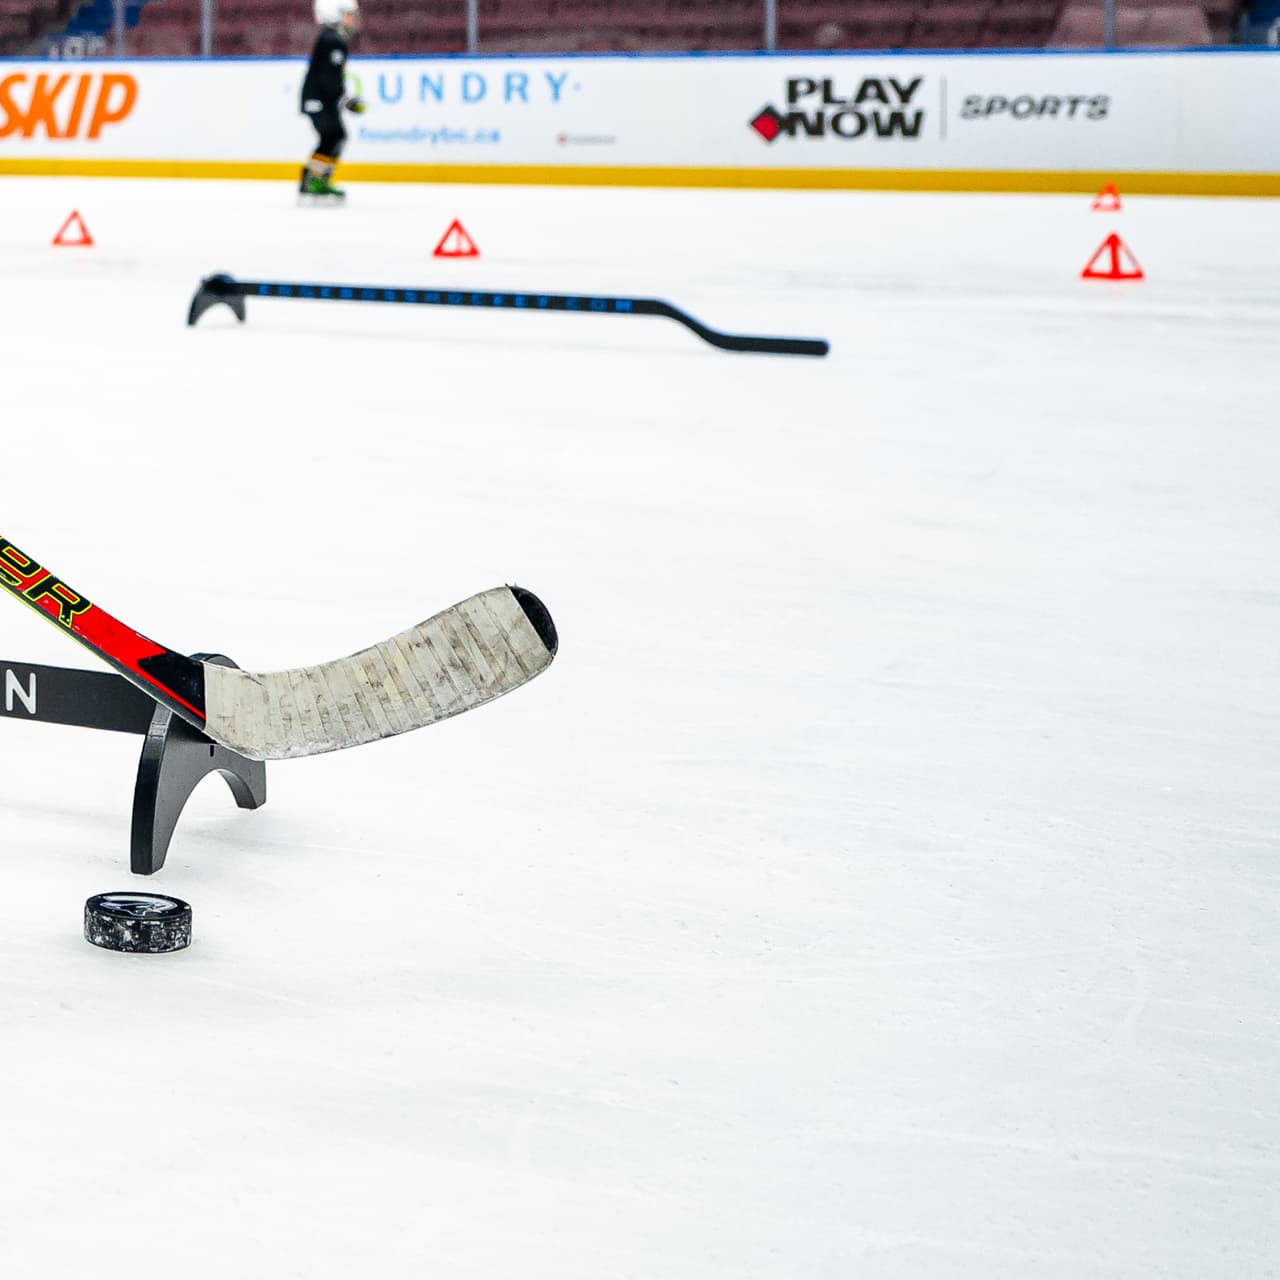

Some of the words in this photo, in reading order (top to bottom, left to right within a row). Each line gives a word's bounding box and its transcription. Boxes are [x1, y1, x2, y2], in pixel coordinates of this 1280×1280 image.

[785, 76, 925, 105] PLAY
[959, 93, 1111, 120] SPORTS
[785, 111, 925, 139] NOW
